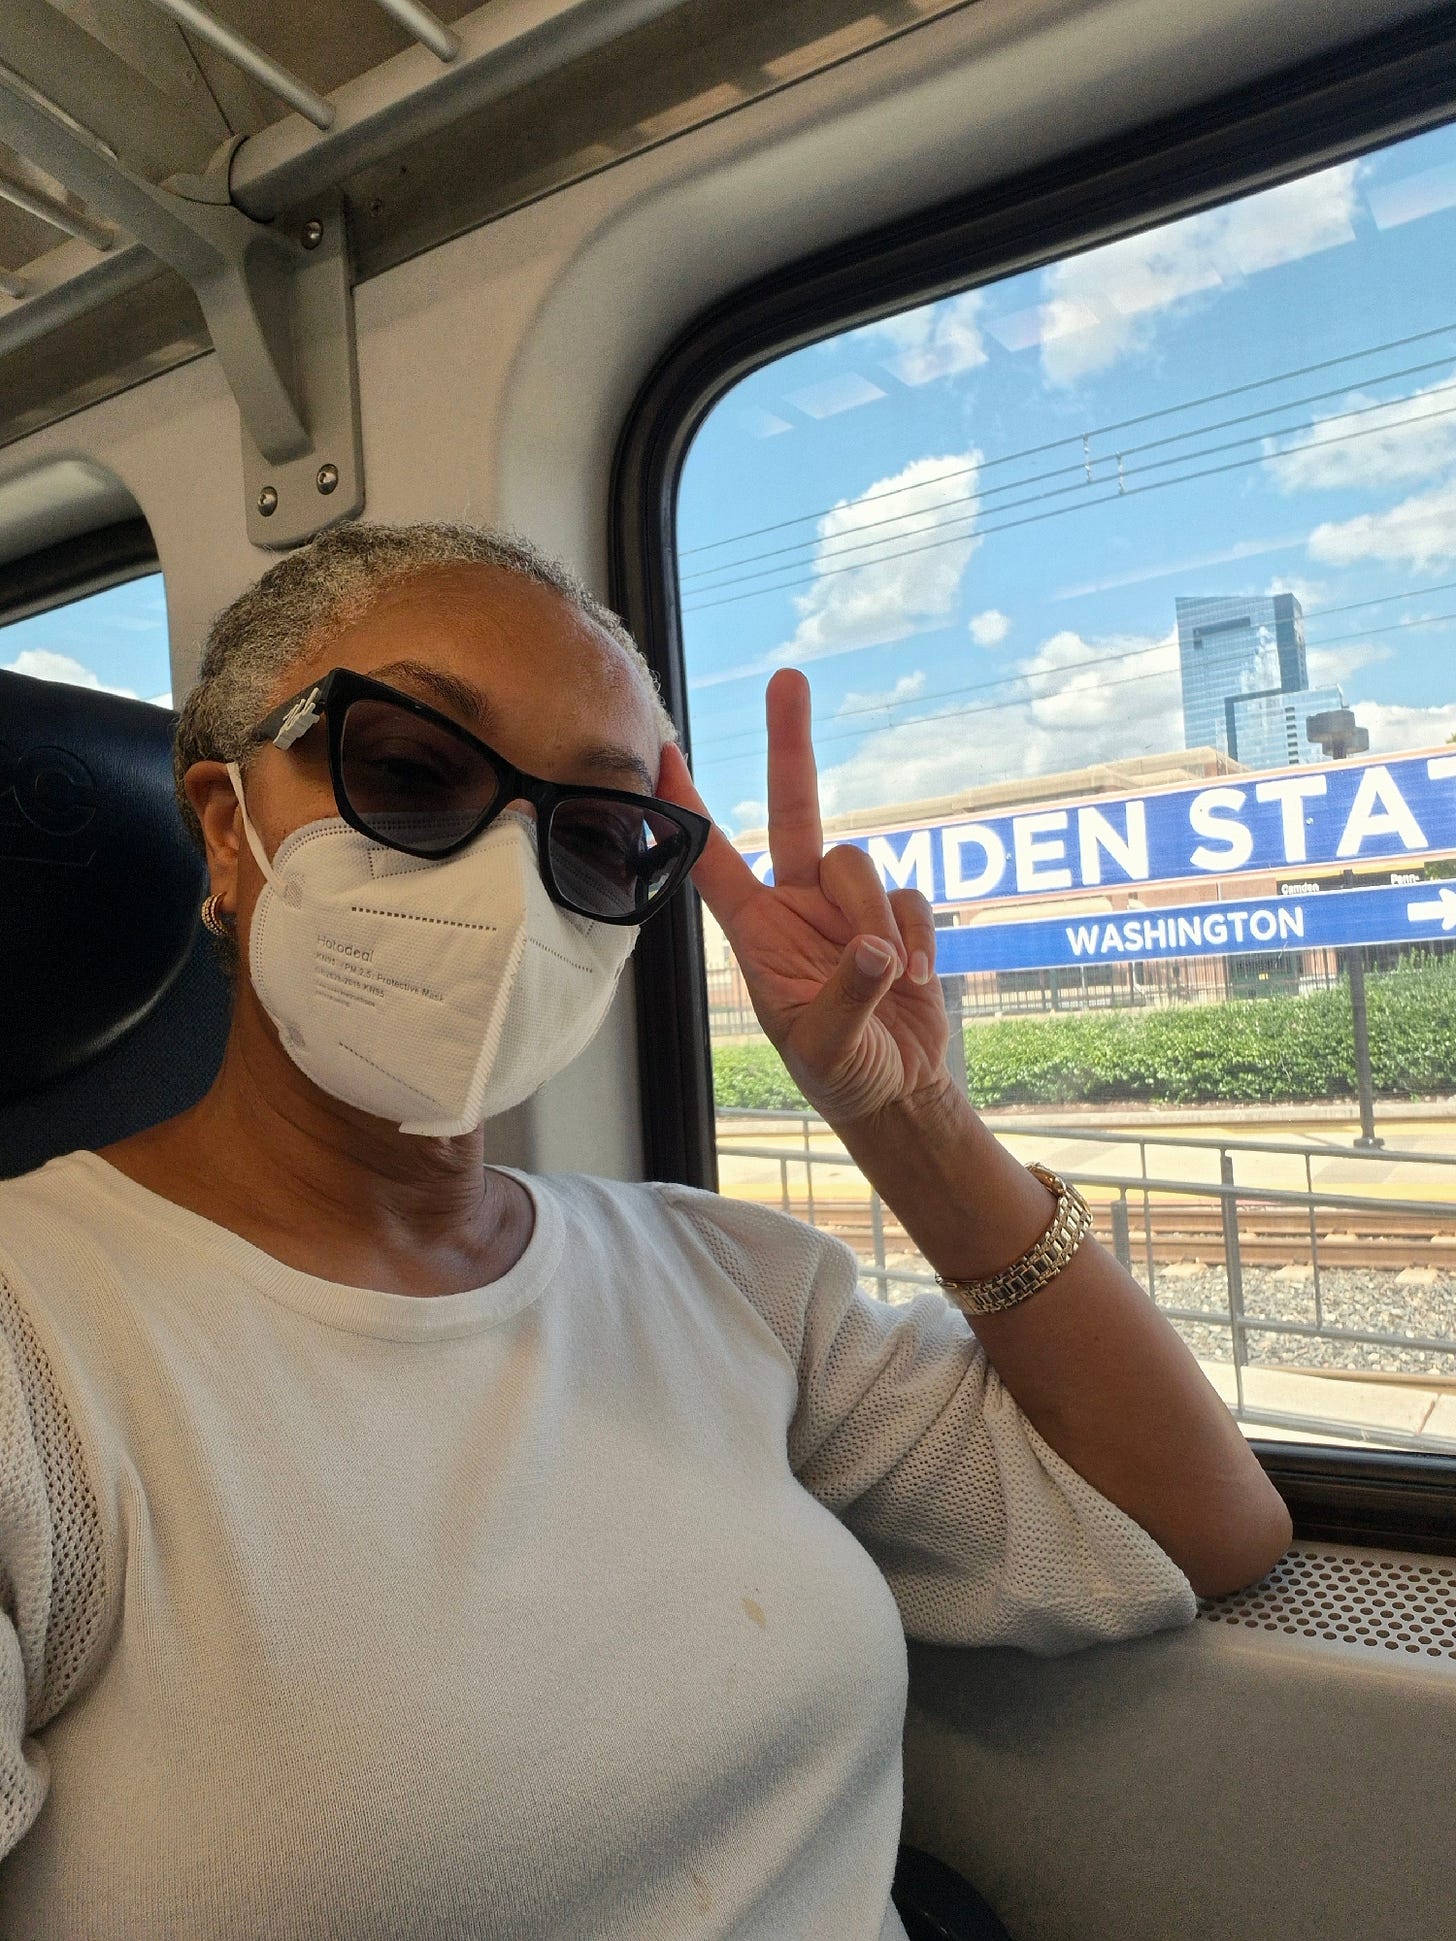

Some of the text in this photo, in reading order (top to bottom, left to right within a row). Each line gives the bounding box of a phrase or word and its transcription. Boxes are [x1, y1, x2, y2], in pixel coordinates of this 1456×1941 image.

[750, 801, 1149, 902] MDEN
[317, 934, 374, 962] Hotodeal
[1066, 906, 1305, 956] WASHINGTON
